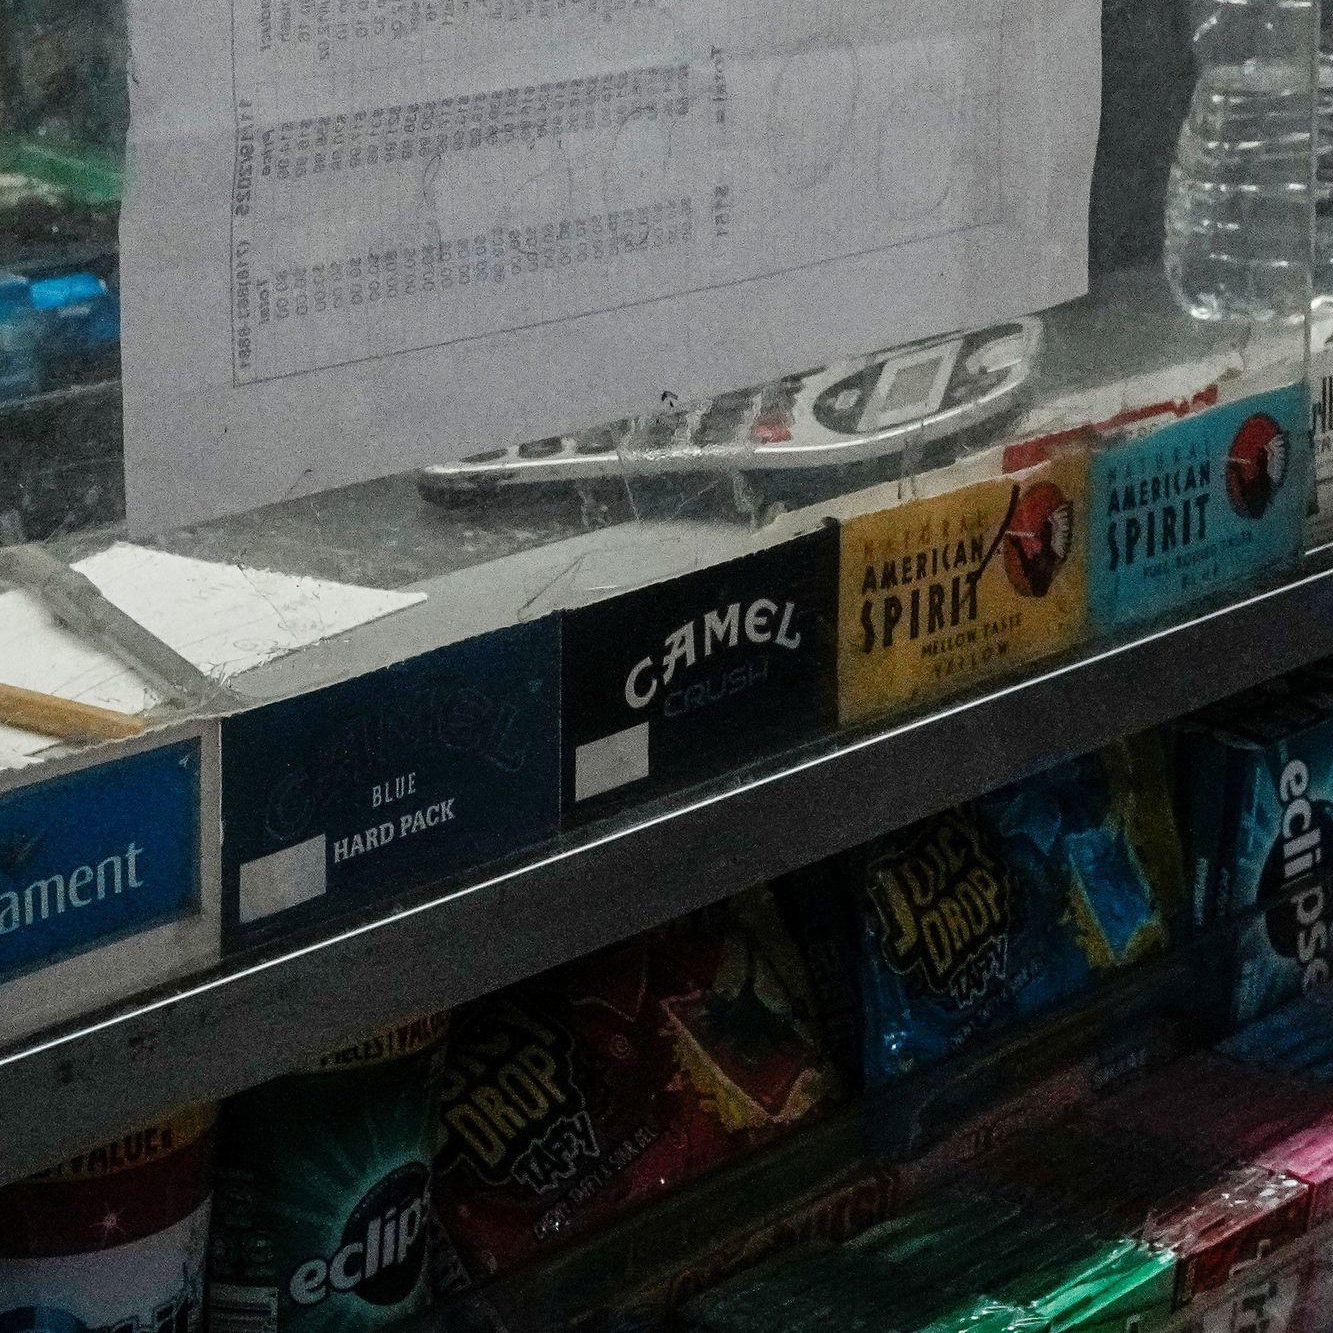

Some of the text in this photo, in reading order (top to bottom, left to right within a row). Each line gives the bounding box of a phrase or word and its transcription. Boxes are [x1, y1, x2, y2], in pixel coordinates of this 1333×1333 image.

[1108, 459, 1211, 514] AMERICAN
[862, 534, 983, 595] AMERICAN
[1108, 492, 1210, 571] SPIRIT
[861, 569, 983, 654] SPIRIT
[921, 628, 977, 658] MELLOW
[625, 598, 801, 709] CAMEL
[371, 772, 418, 809] BLUE
[333, 798, 457, 864] HARD PACK
[919, 868, 1000, 975] DROP
[445, 1043, 567, 1169] DROP
